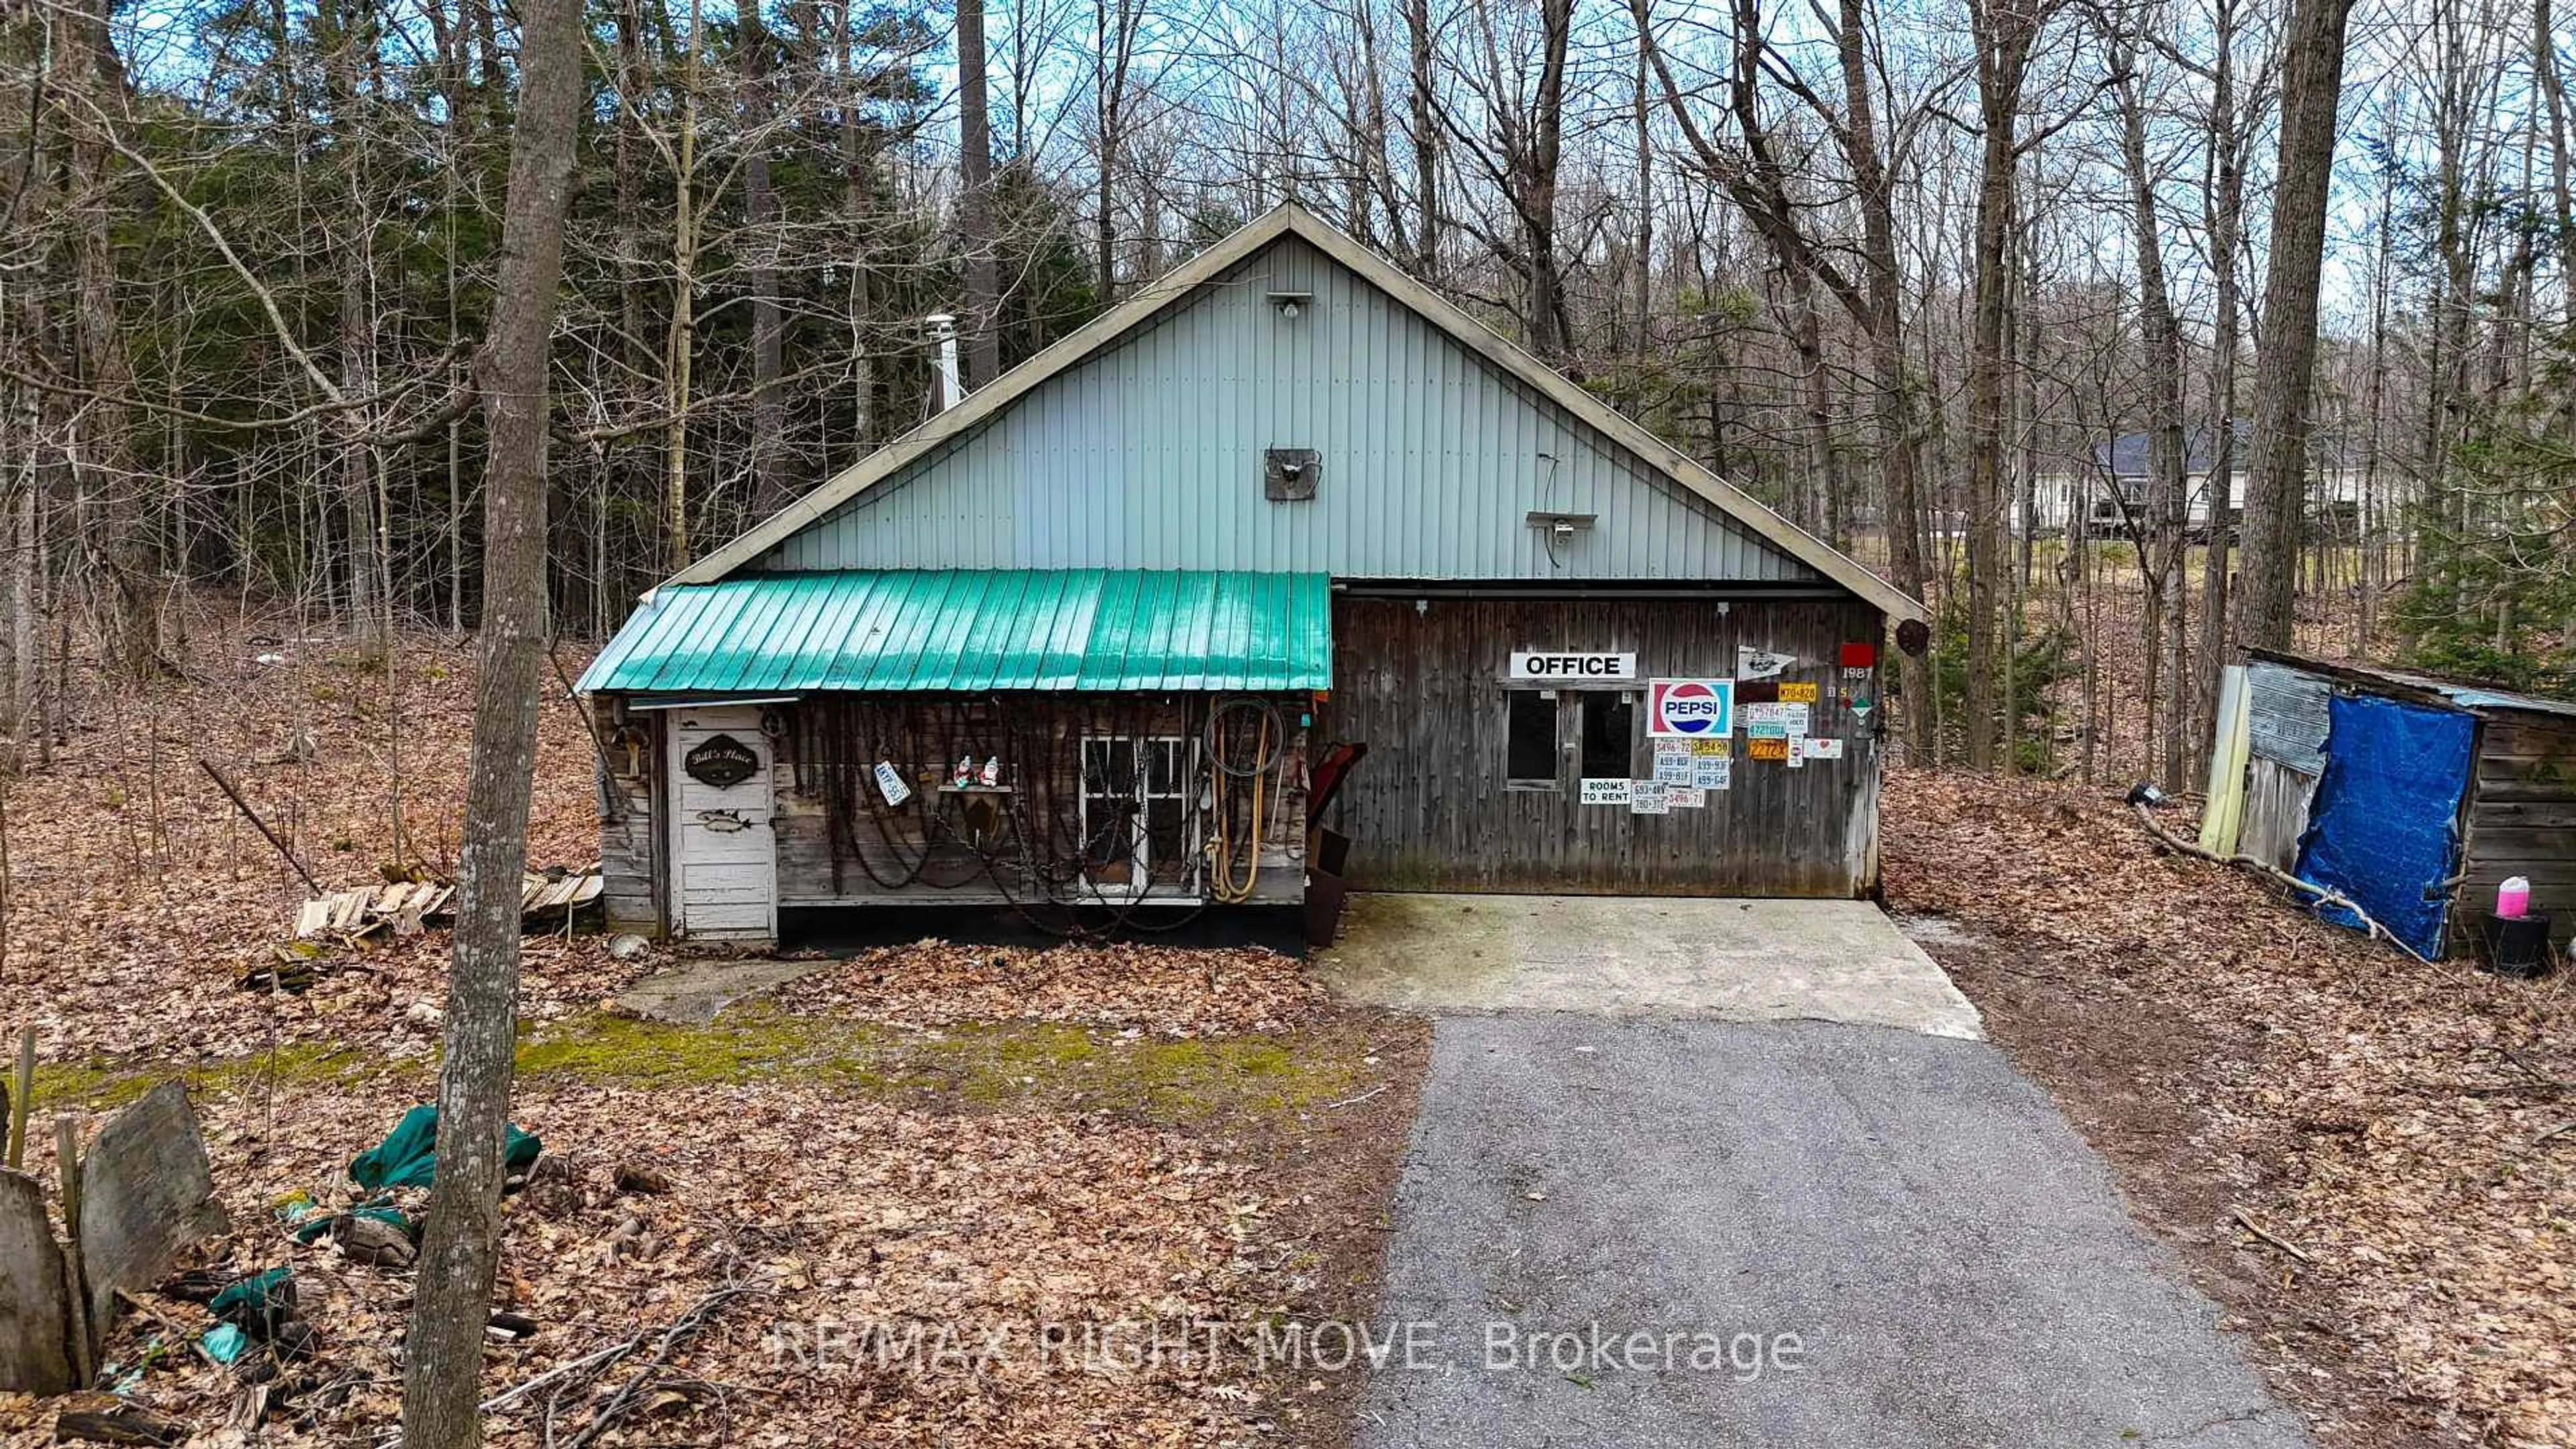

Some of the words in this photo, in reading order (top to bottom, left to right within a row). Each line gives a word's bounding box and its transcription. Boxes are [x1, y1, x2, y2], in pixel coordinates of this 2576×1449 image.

[1526, 657, 1620, 675] OFFICE
[1843, 666, 1873, 679] 1987
[1665, 701, 1717, 714] PEPSI
[693, 749, 720, 765] Bill's
[1589, 782, 1625, 790] ROOMS
[1583, 792, 1599, 801] TO
[1601, 792, 1629, 801] RENT
